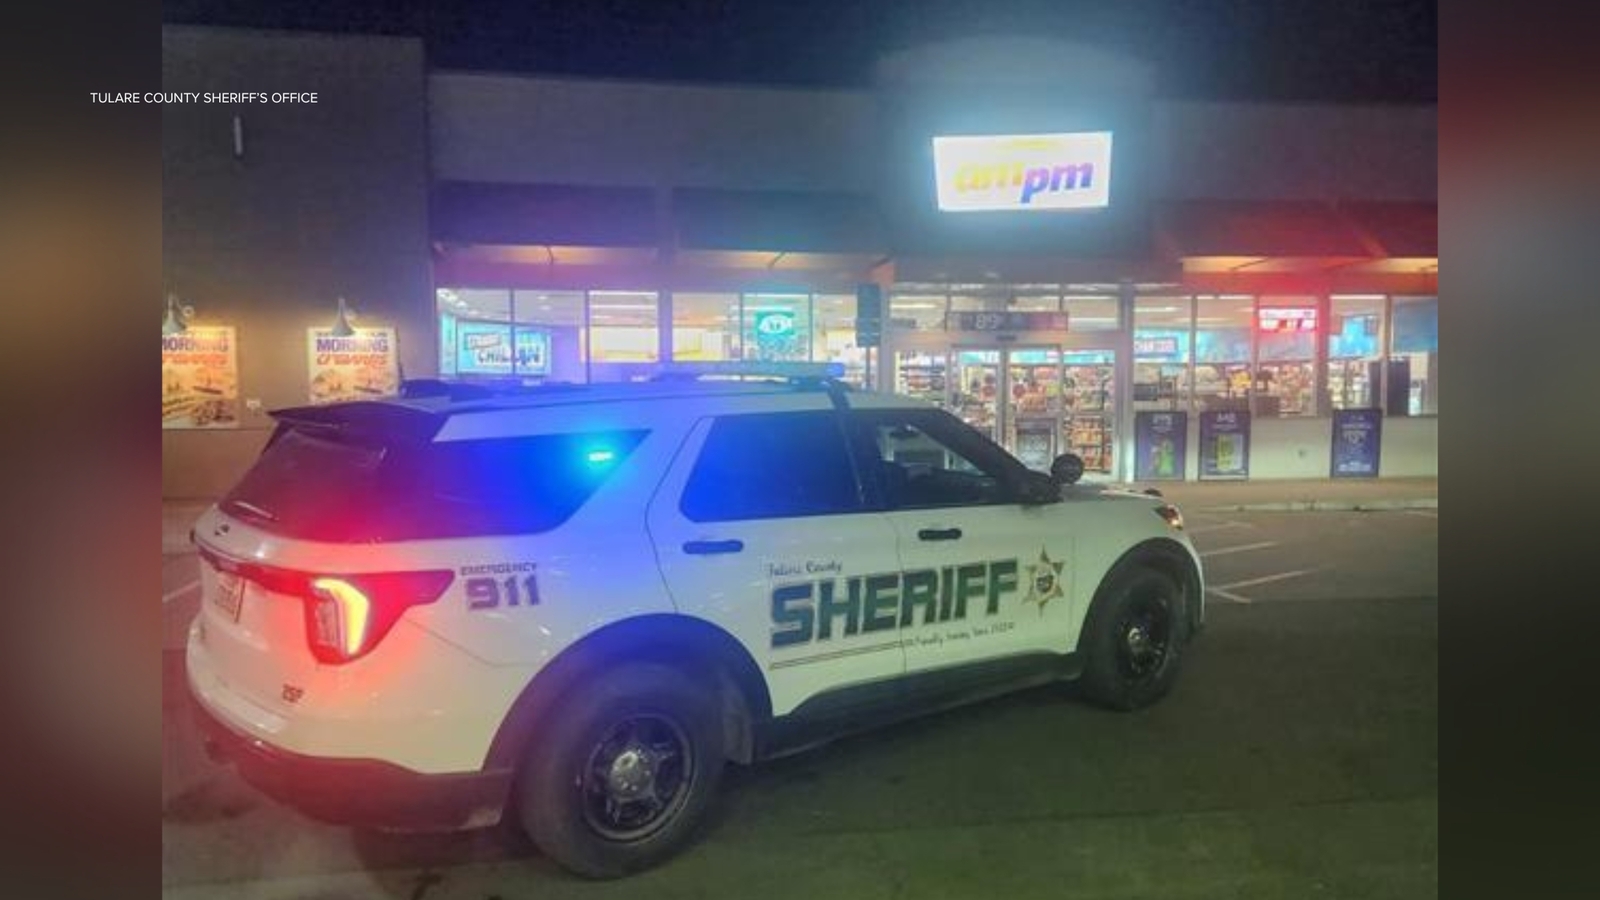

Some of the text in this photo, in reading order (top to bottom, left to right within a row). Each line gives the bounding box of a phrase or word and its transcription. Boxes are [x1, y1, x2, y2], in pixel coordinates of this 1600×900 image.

[316, 338, 388, 353] MORNING
[461, 562, 537, 576] EMERGENCY
[465, 575, 540, 610] 911
[771, 558, 1018, 648] SHERIFF
